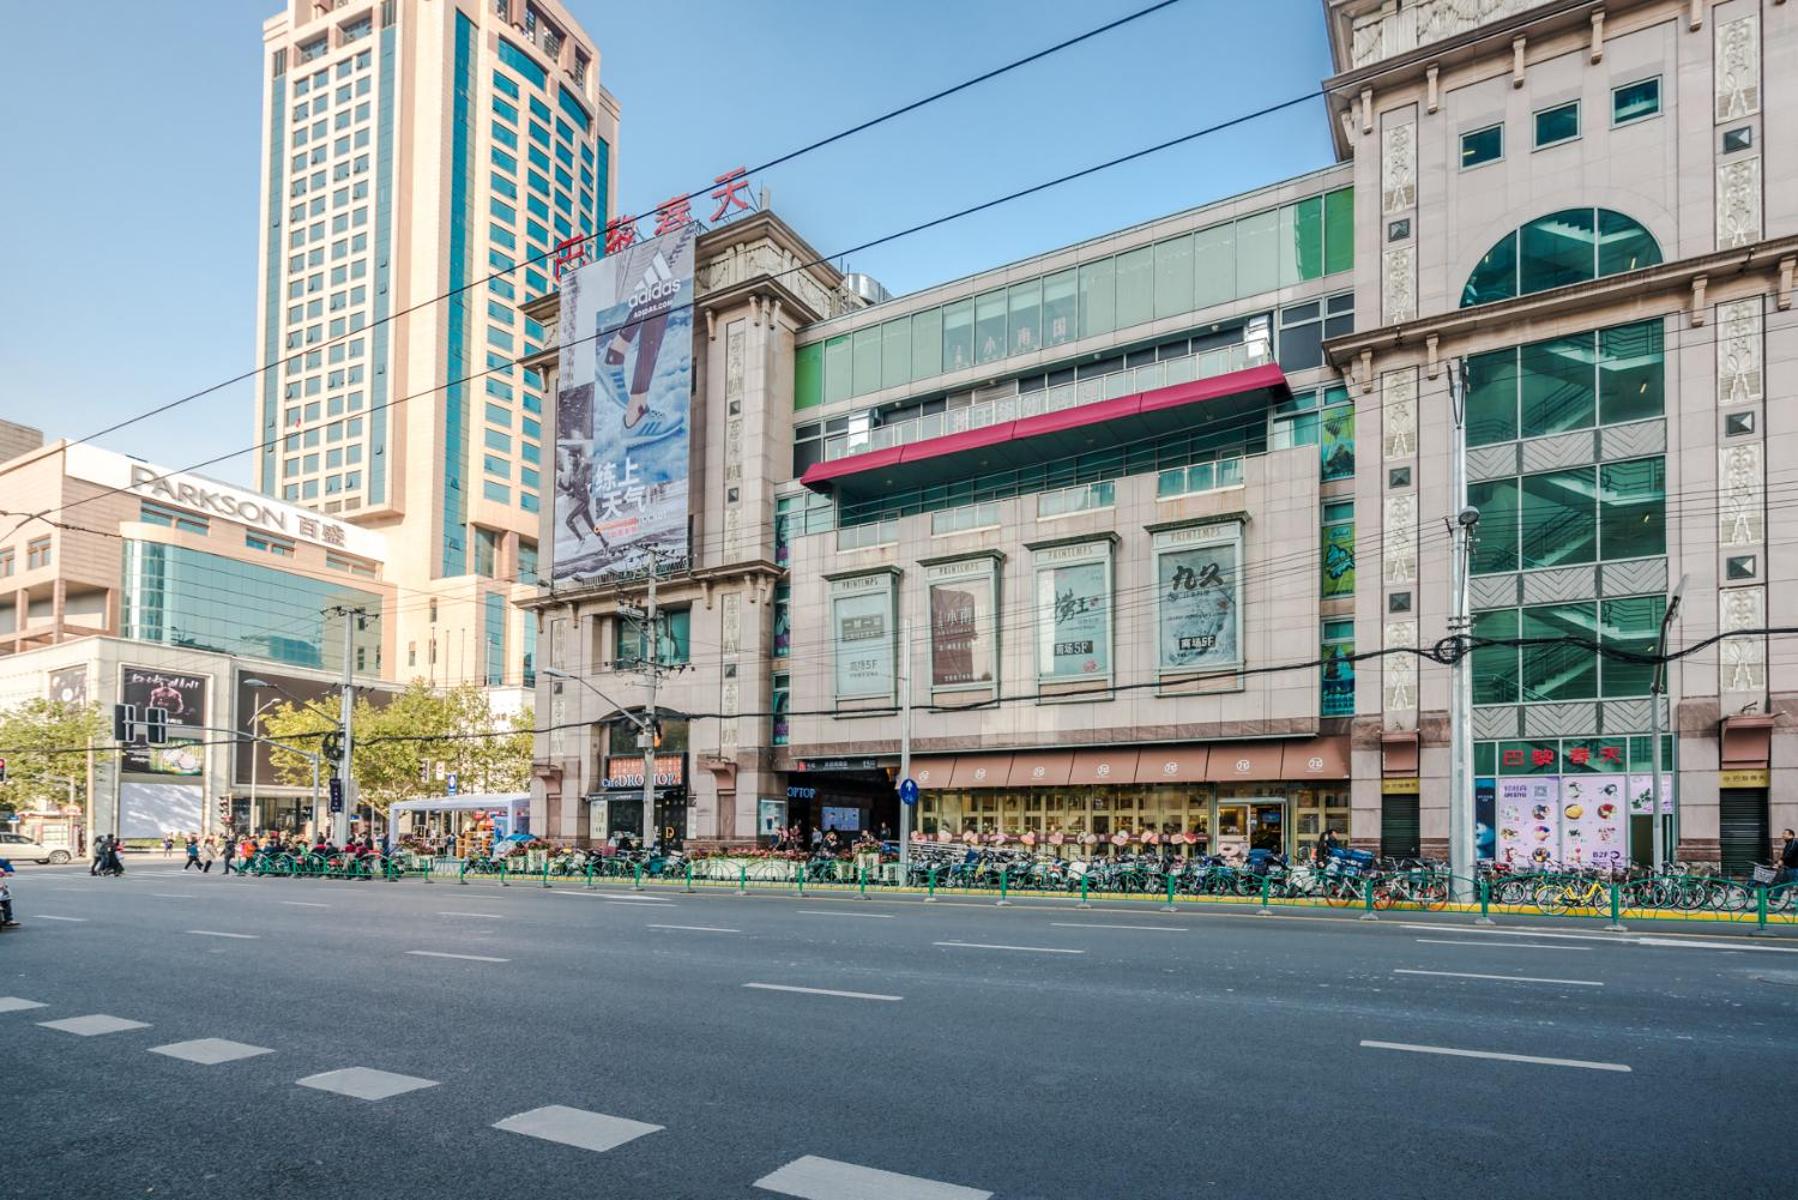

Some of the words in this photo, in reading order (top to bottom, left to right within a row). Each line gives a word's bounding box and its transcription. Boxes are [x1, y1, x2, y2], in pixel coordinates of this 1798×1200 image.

[628, 279, 681, 308] adidas
[594, 457, 640, 491] 练上
[131, 464, 288, 531] PARKSON
[601, 485, 646, 521] 天气
[296, 514, 347, 547] 百盛
[1055, 641, 1088, 655] 商场5F
[1502, 746, 1622, 766] 巴黎春天
[619, 774, 675, 787] DROTOP
